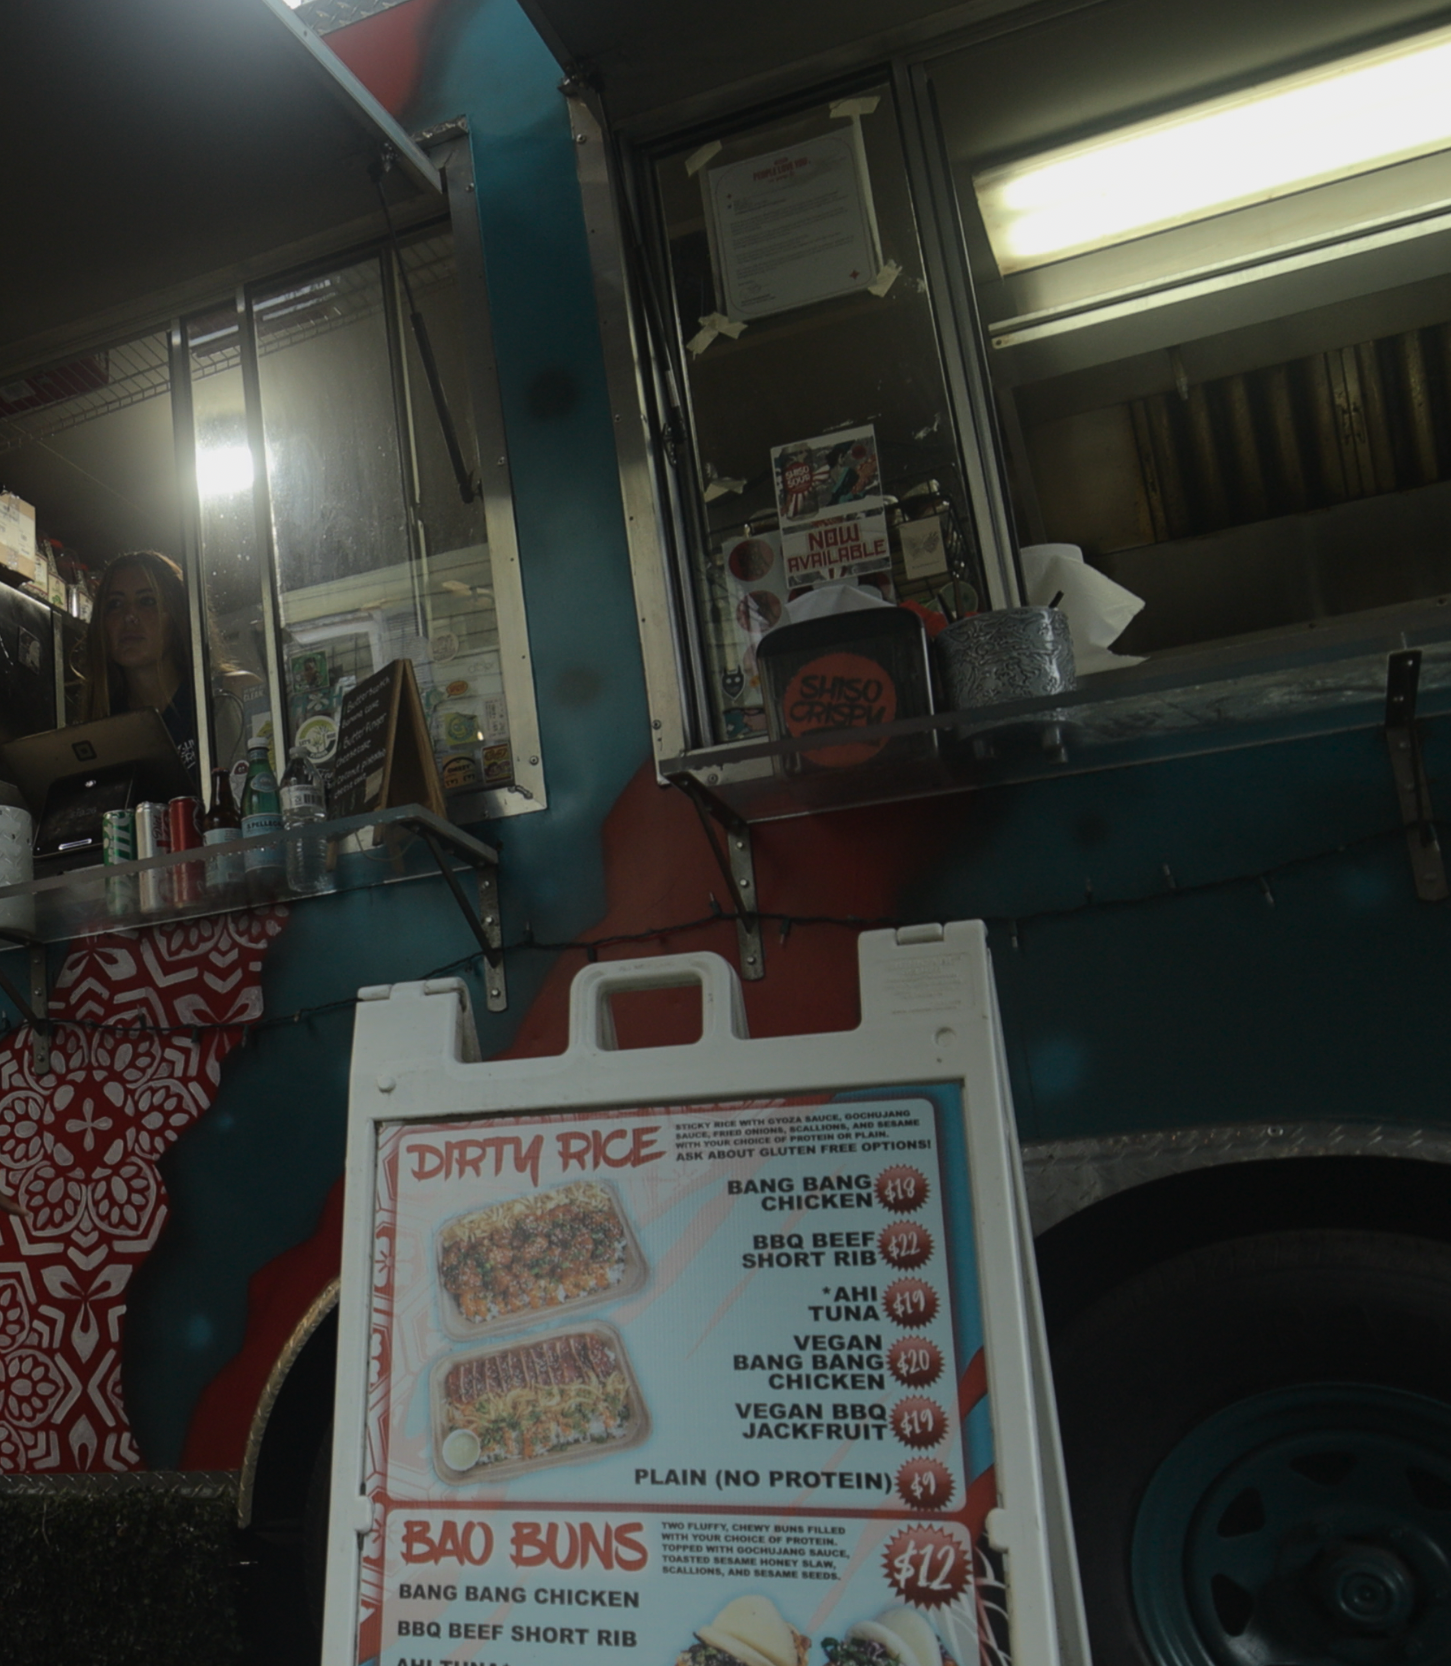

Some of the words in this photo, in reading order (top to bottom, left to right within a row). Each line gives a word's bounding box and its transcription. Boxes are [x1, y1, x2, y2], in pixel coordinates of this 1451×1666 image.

[785, 465, 810, 480] SHISO
[808, 523, 860, 551] NOW
[787, 538, 886, 573] AVAILABLE
[800, 674, 884, 704] SHISO
[789, 700, 887, 727] CRISPY
[676, 1121, 710, 1131] STICKY
[714, 1120, 737, 1129] RICE
[739, 1118, 765, 1127] WITH
[768, 1116, 802, 1126] GYOZA
[805, 1113, 842, 1123] SAUCE,
[845, 1110, 911, 1121] GOCHUJANG
[676, 1131, 711, 1141] SAUCE,
[713, 1129, 742, 1138] FRIED
[745, 1126, 787, 1136] ONIONS,
[790, 1123, 850, 1134] SCALLIONS,
[853, 1121, 874, 1129] AND
[877, 1118, 920, 1128] SESAME
[676, 1141, 701, 1150] WITH
[703, 1139, 730, 1148] YOUR
[733, 1137, 771, 1146] CHOICE
[774, 1136, 787, 1144] OF
[790, 1133, 835, 1143] PROTEIN
[838, 1132, 851, 1140] OR
[854, 1130, 890, 1140] PLAIN.
[676, 1151, 703, 1161] ASK
[708, 1149, 754, 1160] ABOUT
[760, 1146, 815, 1158] GLUTEN
[820, 1143, 857, 1154] FREE
[861, 1140, 932, 1152] OPTIONS!
[406, 1134, 544, 1188] DIRTY
[556, 1126, 667, 1172] RICE
[727, 1178, 794, 1194] BANG
[803, 1174, 872, 1191] BANG
[883, 1177, 916, 1205] $18
[761, 1193, 873, 1211] CHICKEN
[753, 1234, 804, 1250] BBQ
[812, 1231, 875, 1248] BEEF
[888, 1233, 921, 1260] $22
[742, 1251, 826, 1269] SHORT
[834, 1250, 877, 1266] RIB
[893, 1289, 925, 1317] $19
[808, 1306, 880, 1322] TUNA
[793, 1335, 882, 1351] VEGAN
[733, 1354, 803, 1371] BANG
[812, 1354, 884, 1371] BANG
[897, 1351, 930, 1377] $20
[768, 1373, 885, 1391] CHICKEN
[735, 1403, 823, 1420] VEGAN
[832, 1403, 887, 1421] BBQ
[742, 1422, 887, 1441] JACKFRUIT
[901, 1410, 934, 1437] $19
[635, 1469, 707, 1486] PLAIN
[715, 1469, 760, 1491] (NO
[769, 1471, 893, 1494] PROTEIN)
[910, 1468, 936, 1499] $9
[661, 1521, 685, 1530] TWO
[688, 1523, 729, 1534] FLUFFY,
[732, 1523, 771, 1533] CHEWY
[774, 1525, 804, 1534] BUNS
[807, 1525, 846, 1535] FILLED
[401, 1520, 494, 1567] BAO
[510, 1521, 649, 1572] BUNS
[661, 1532, 688, 1542] WITH
[691, 1533, 720, 1543] YOUR
[724, 1534, 764, 1544] CHOICE
[768, 1535, 782, 1544] OF
[786, 1536, 838, 1547] PROTEIN.
[662, 1544, 703, 1553] TOPPED
[705, 1545, 734, 1554] WITH
[736, 1545, 806, 1556] GOCHUJANG
[809, 1548, 851, 1560] SAUCE,
[662, 1554, 710, 1565] TOASTED
[713, 1556, 758, 1566] SESAME
[760, 1557, 799, 1568] HONEY
[802, 1559, 837, 1570] SLAW,
[662, 1566, 725, 1577] SCALLIONS,
[727, 1568, 751, 1577] AND
[753, 1568, 799, 1579] SESAME
[802, 1570, 842, 1581] SEEDS.
[894, 1540, 954, 1590] $12
[399, 1583, 457, 1601] BANG
[465, 1585, 527, 1604] BANG
[534, 1588, 639, 1608] CHICKEN
[398, 1620, 442, 1639] BBQ
[448, 1623, 504, 1640] BEEF
[511, 1625, 589, 1645] SHORT
[597, 1629, 637, 1647] RIB
